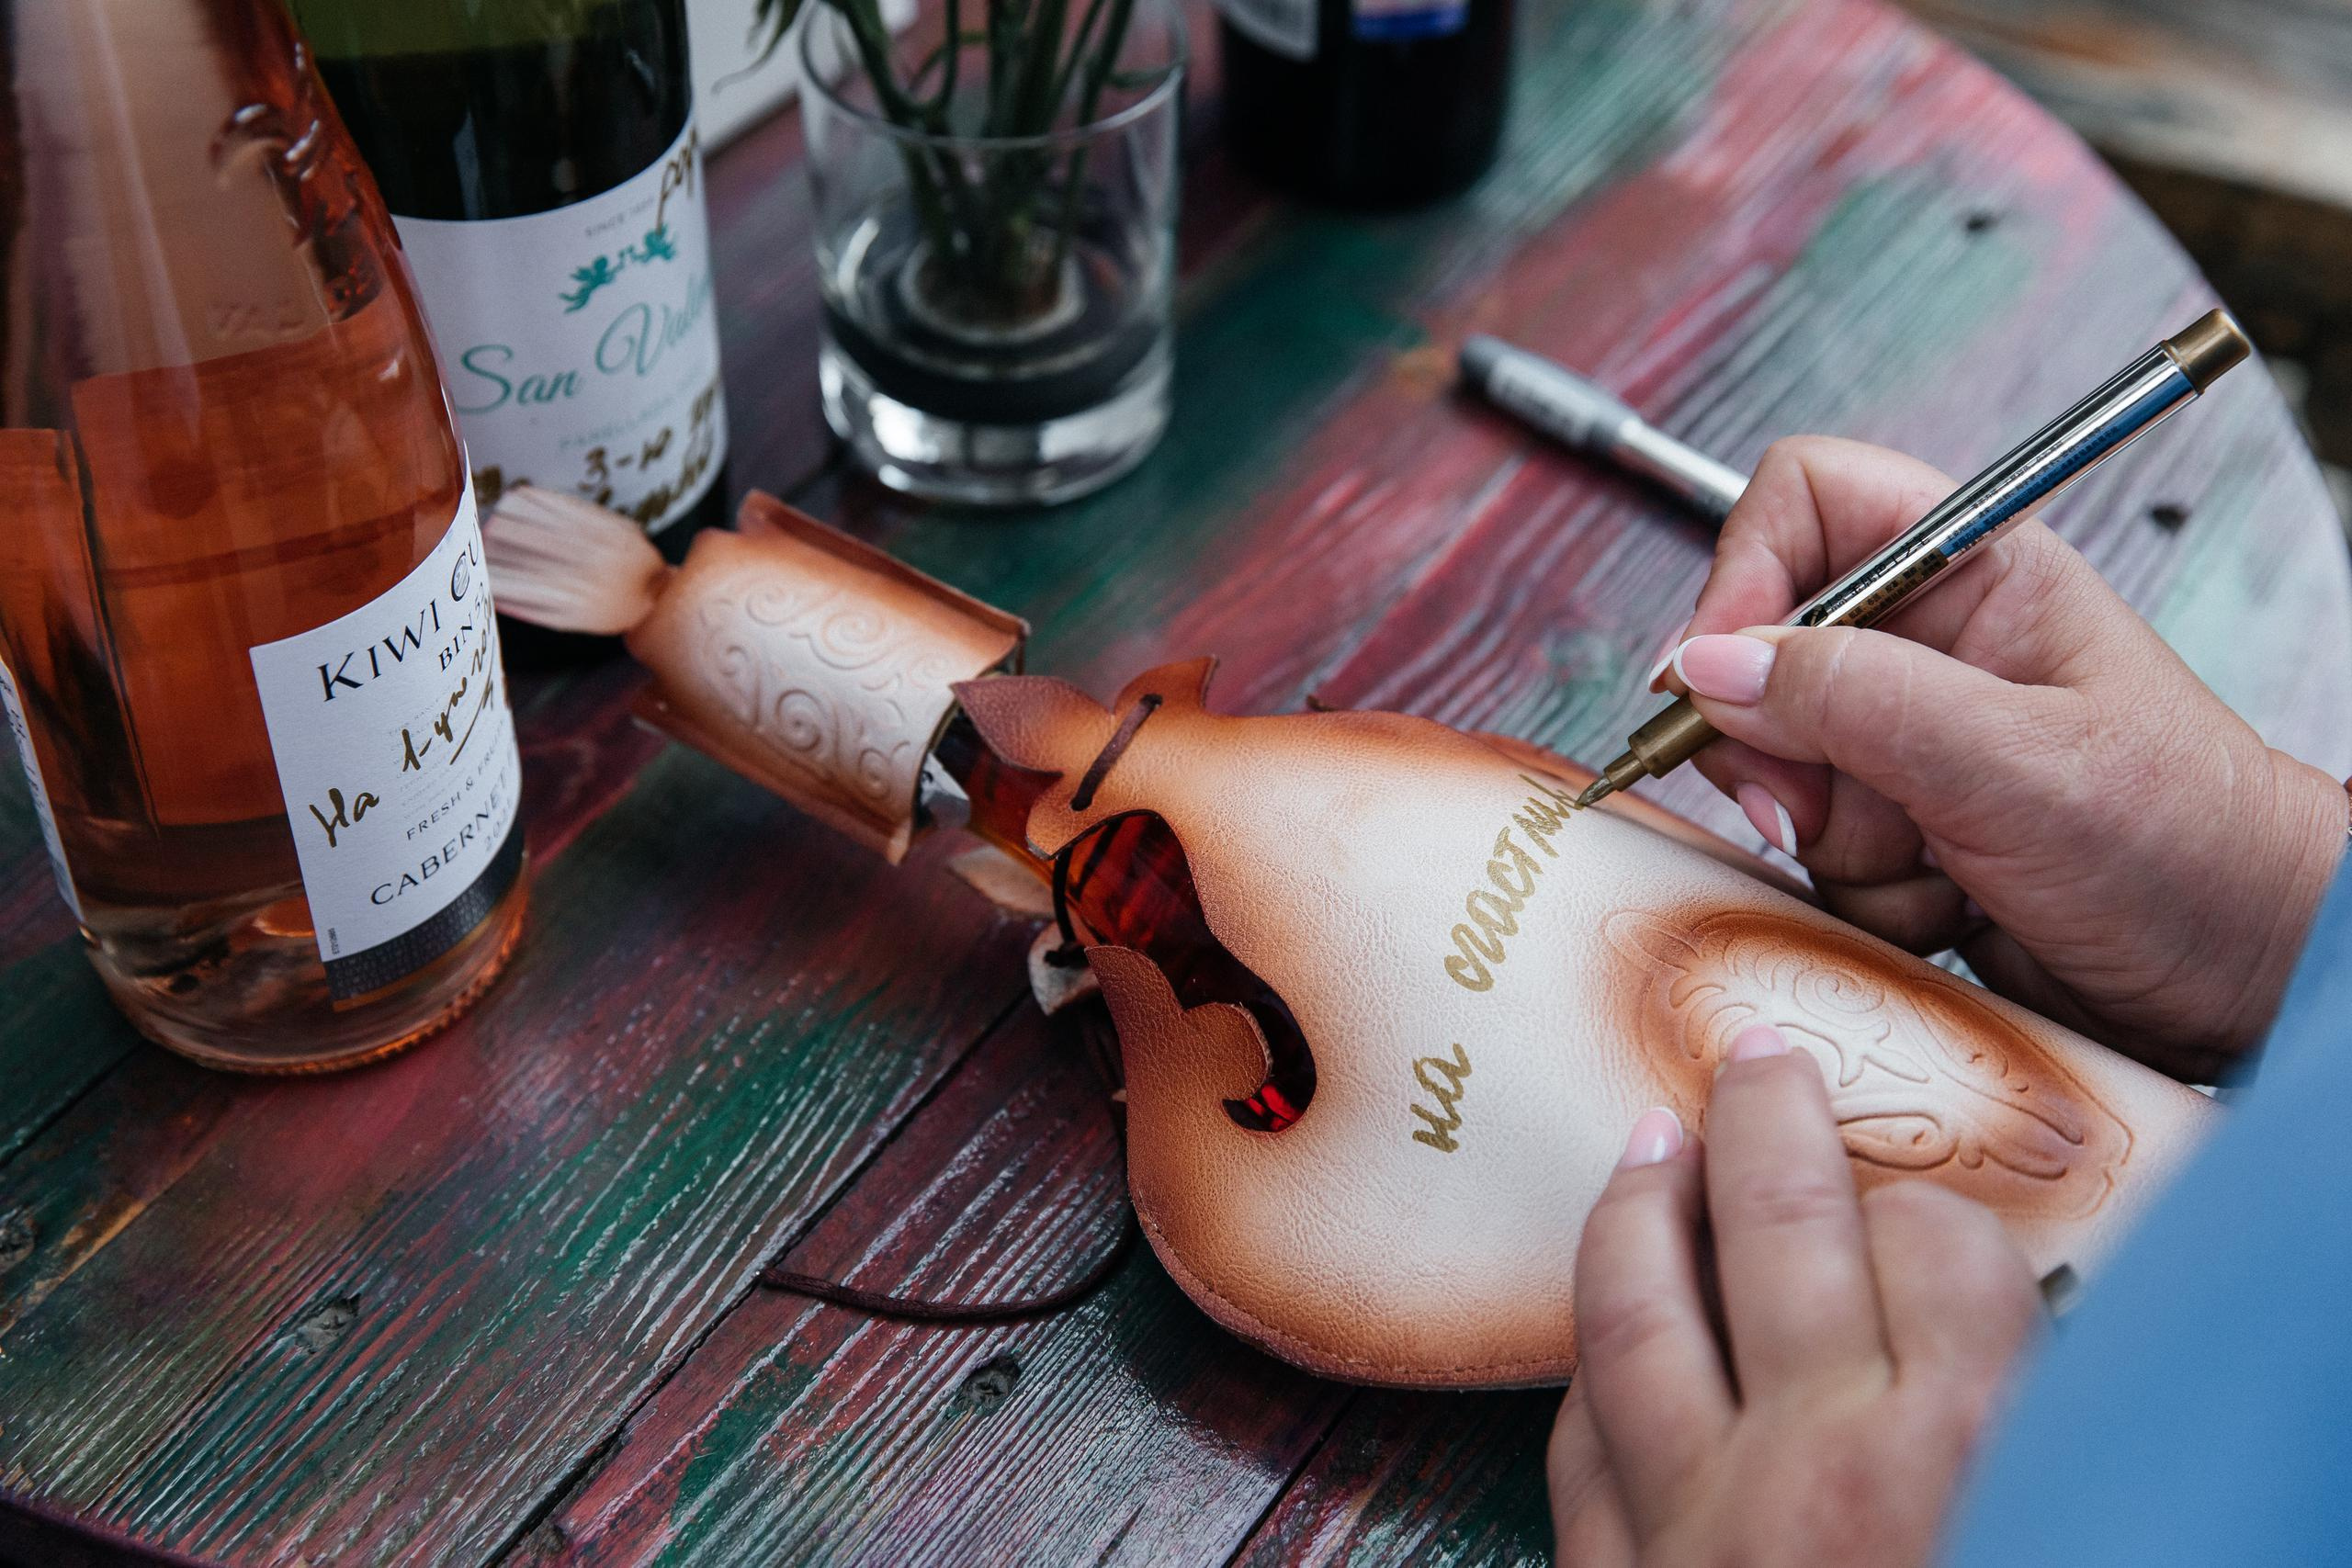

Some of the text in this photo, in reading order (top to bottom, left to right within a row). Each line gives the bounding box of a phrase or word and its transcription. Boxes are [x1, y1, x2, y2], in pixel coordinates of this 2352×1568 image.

[456, 344, 577, 414] San
[318, 599, 440, 702] KIWI
[451, 514, 481, 602] CU
[438, 613, 473, 671] BIN
[309, 788, 379, 848] На
[370, 766, 506, 905] CABERNET
[407, 791, 461, 840] FRESH
[465, 778, 474, 792] &
[1411, 1043, 1472, 1154] на
